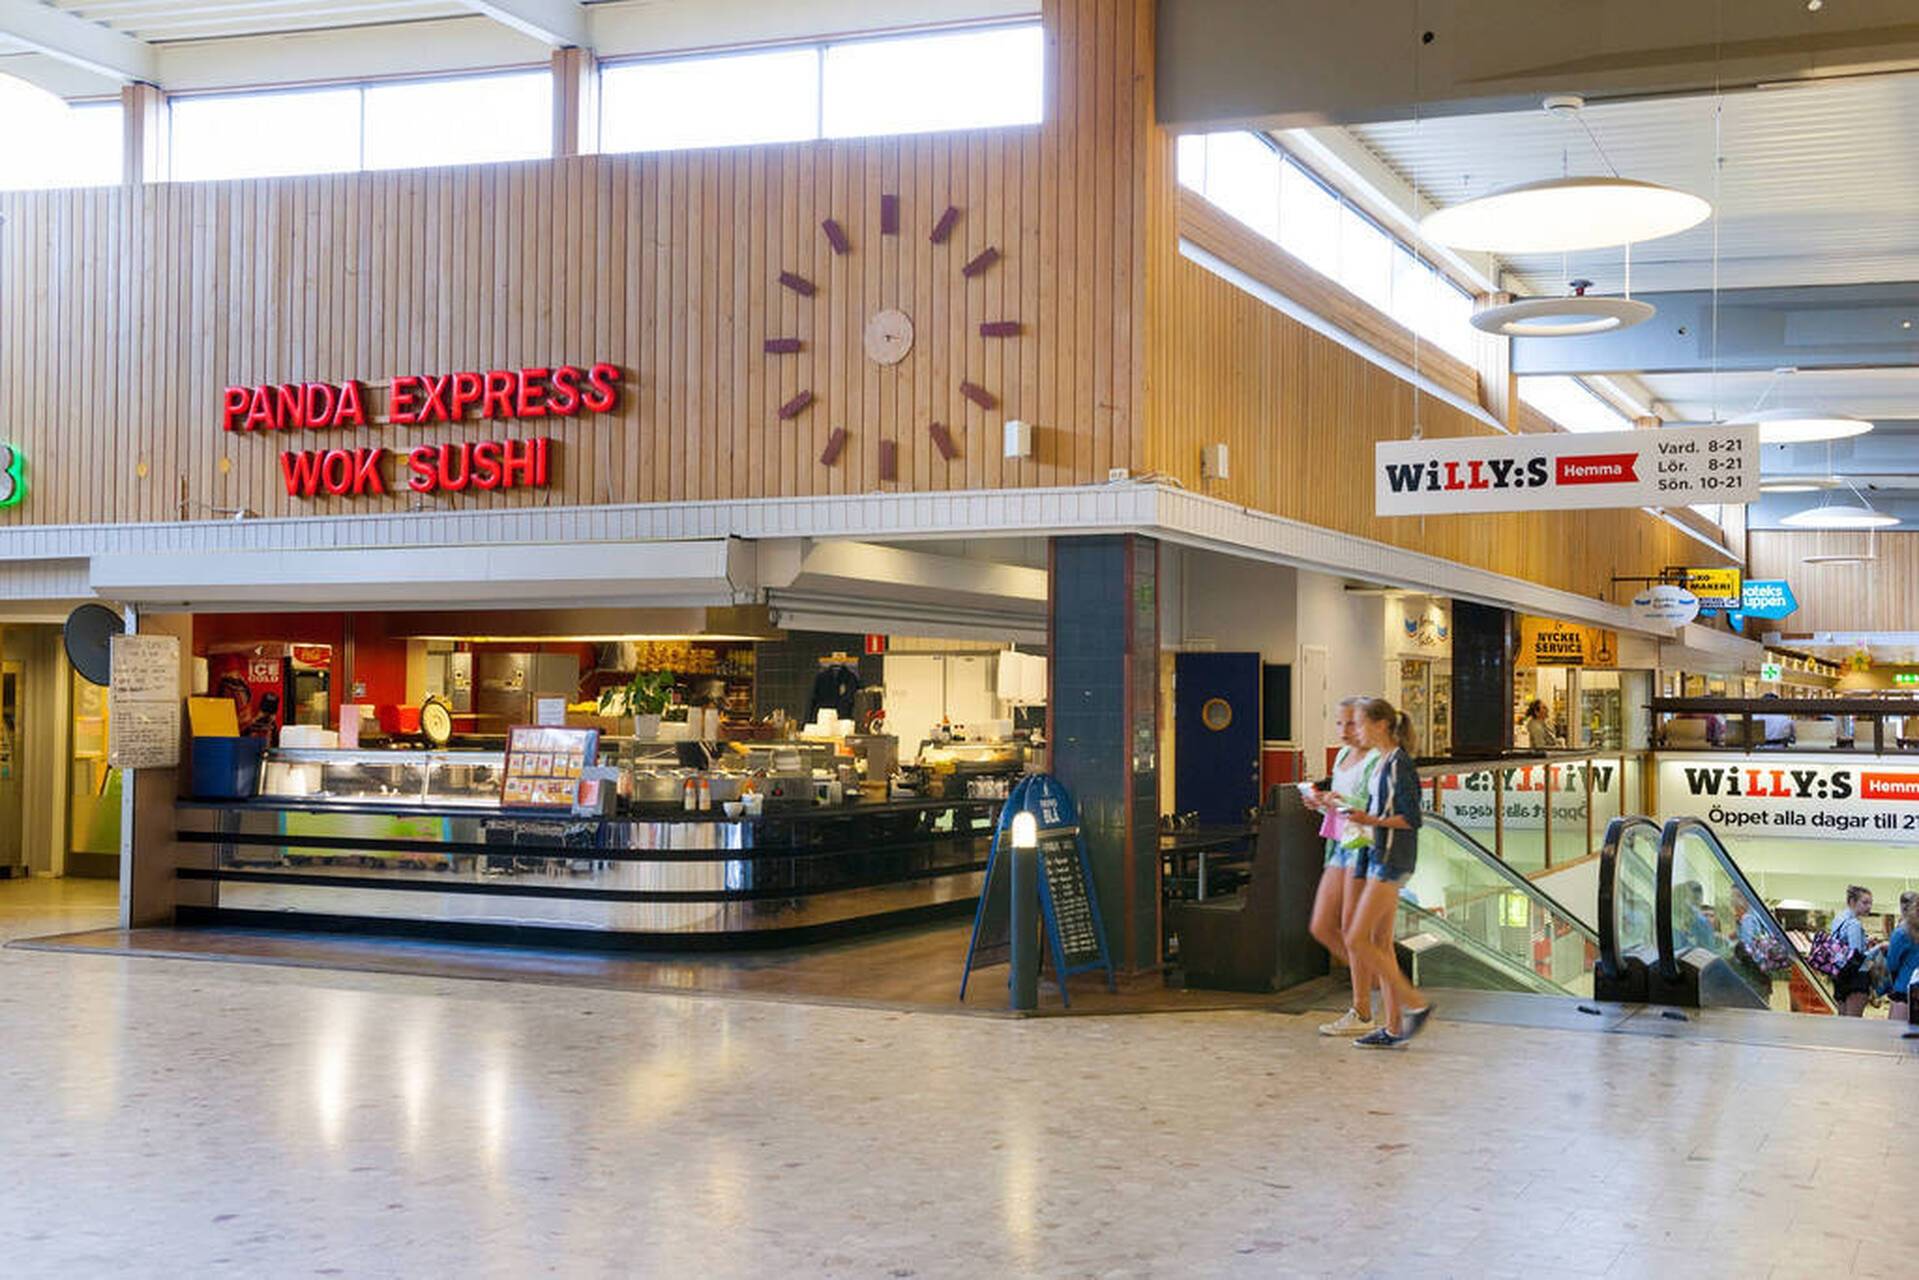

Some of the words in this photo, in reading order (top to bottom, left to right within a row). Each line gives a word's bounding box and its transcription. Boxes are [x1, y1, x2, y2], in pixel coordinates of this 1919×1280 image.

[223, 380, 365, 432] PANDA
[389, 362, 621, 424] EXPRESS
[1658, 440, 1700, 455] Vard.
[1708, 439, 1742, 453] 8-21
[280, 447, 385, 497] WOK
[408, 436, 549, 494] SUSHI
[1563, 464, 1623, 477] Hemma
[1658, 460, 1688, 473] Lör.
[1708, 458, 1742, 471] 8-21
[1658, 477, 1693, 491] Sön.
[1700, 476, 1742, 489] 10-21
[1535, 643, 1583, 653] SERVICE
[248, 660, 280, 675] ICE
[1870, 779, 1919, 793] Hemm
[1709, 804, 1769, 827] Öppet
[1773, 811, 1806, 827] alla
[1812, 811, 1870, 831] dagar
[1873, 813, 1897, 829] till
